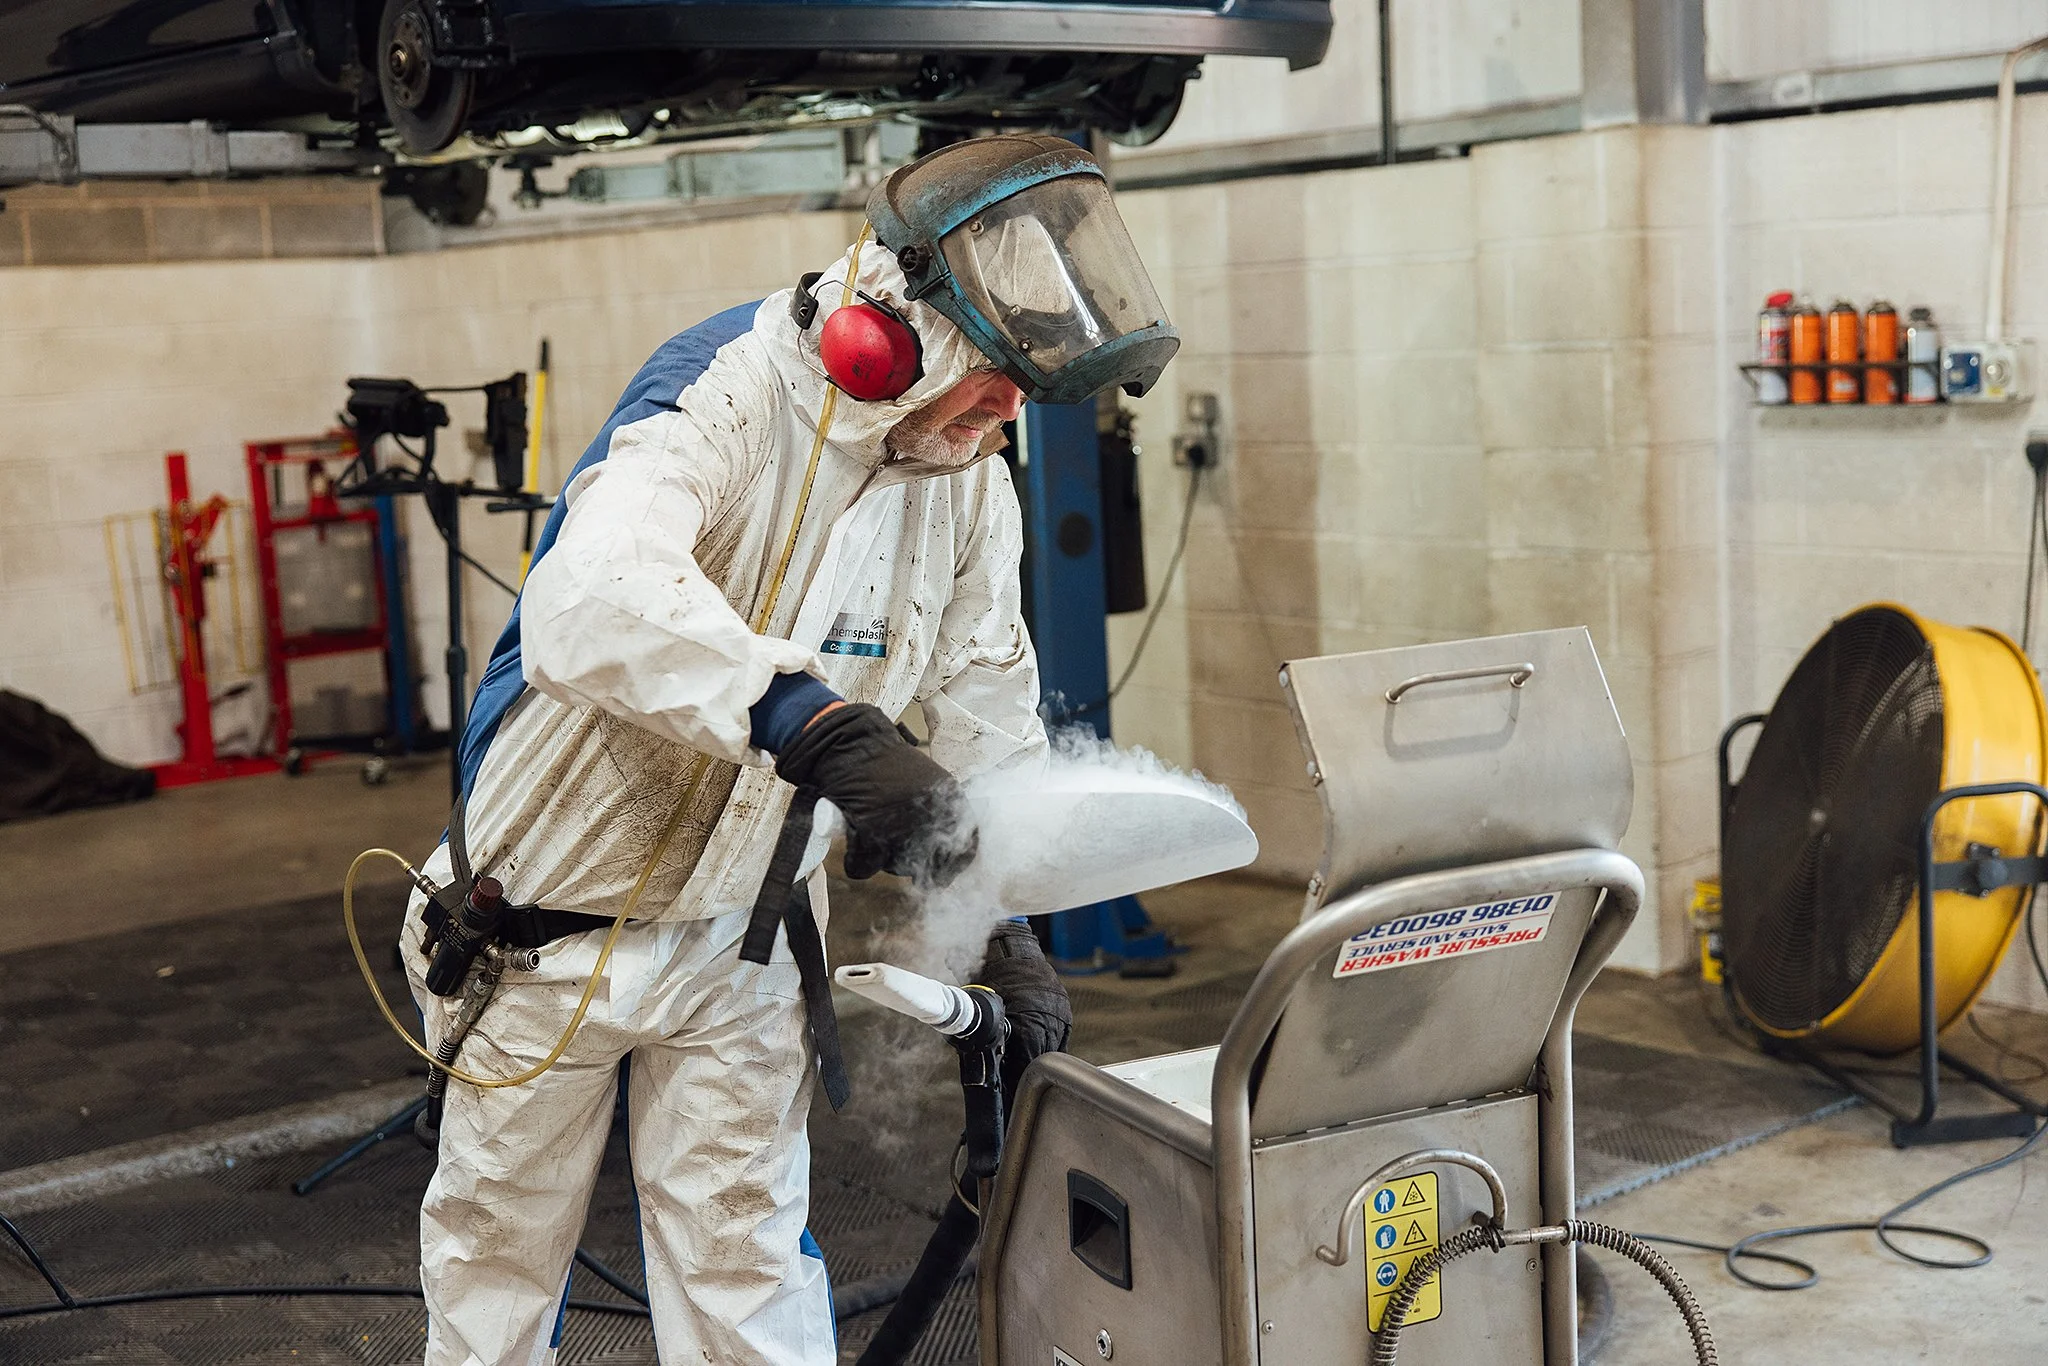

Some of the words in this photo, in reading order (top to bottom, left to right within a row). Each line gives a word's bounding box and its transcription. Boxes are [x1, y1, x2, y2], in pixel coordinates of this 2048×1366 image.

[828, 625, 884, 641] hemsplash
[1469, 894, 1554, 922] 01386
[1419, 931, 1457, 946] AND
[1433, 927, 1543, 956] PRESSURE
[1457, 922, 1510, 940] SALES
[1340, 946, 1432, 972] WASHER
[1346, 938, 1419, 959] SERVICE
